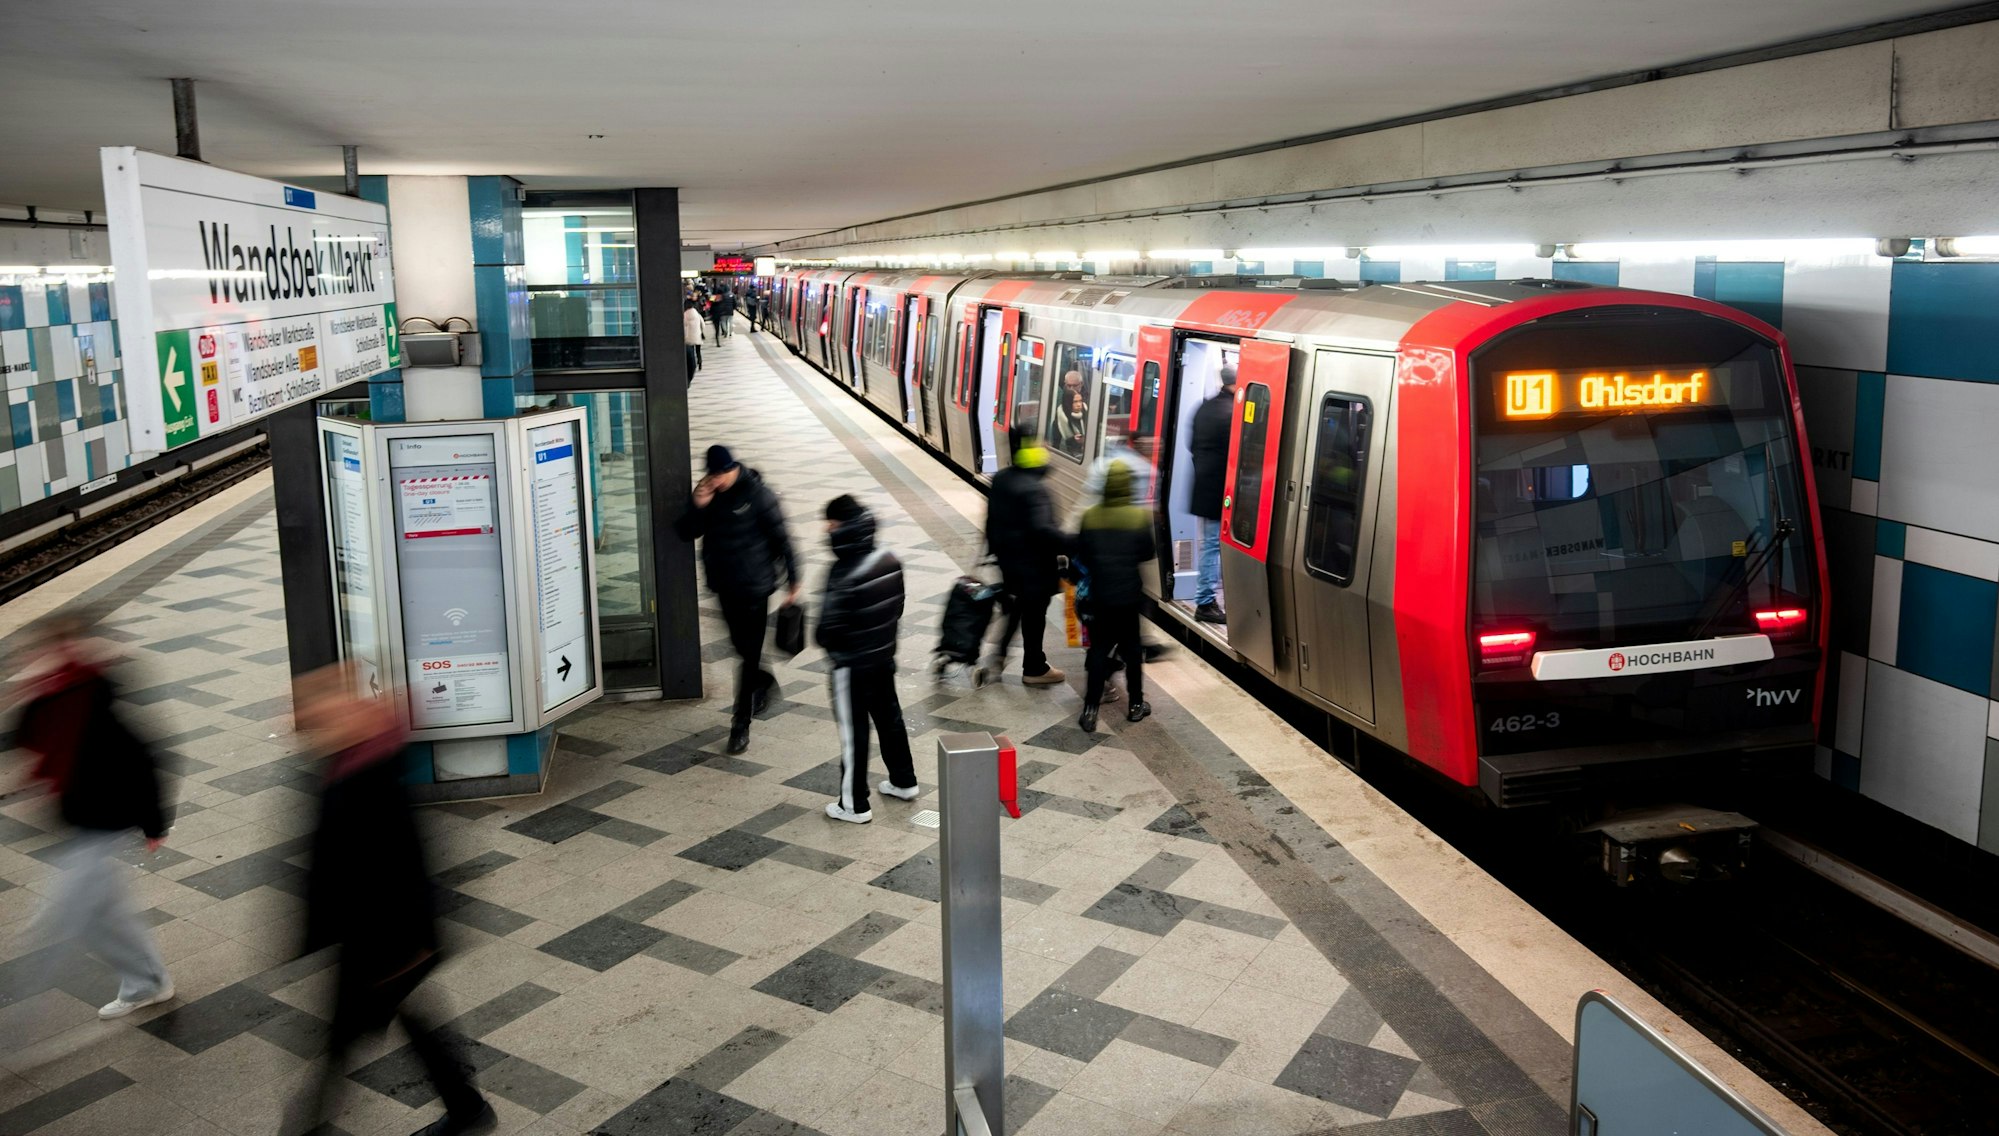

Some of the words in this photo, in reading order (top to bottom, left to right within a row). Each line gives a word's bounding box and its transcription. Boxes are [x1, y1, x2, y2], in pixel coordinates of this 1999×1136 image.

[199, 221, 328, 304] Wandsbek
[328, 234, 375, 295] Markt
[1216, 309, 1268, 328] 462-3
[202, 337, 215, 355] BUS
[242, 328, 281, 352] Wandsbeker
[282, 322, 315, 345] Marktstraße
[202, 365, 218, 383] TAXI
[245, 356, 284, 384] Wandsbeker
[285, 353, 299, 374] Allee
[249, 387, 284, 414] Bezirksamt
[1511, 379, 1545, 412] U1
[1580, 373, 1703, 408] Ohlsdorf
[537, 452, 547, 461] U1
[422, 660, 452, 671] SOS
[1628, 648, 1714, 667] HOCHBAHN
[1490, 711, 1560, 734] 462-3
